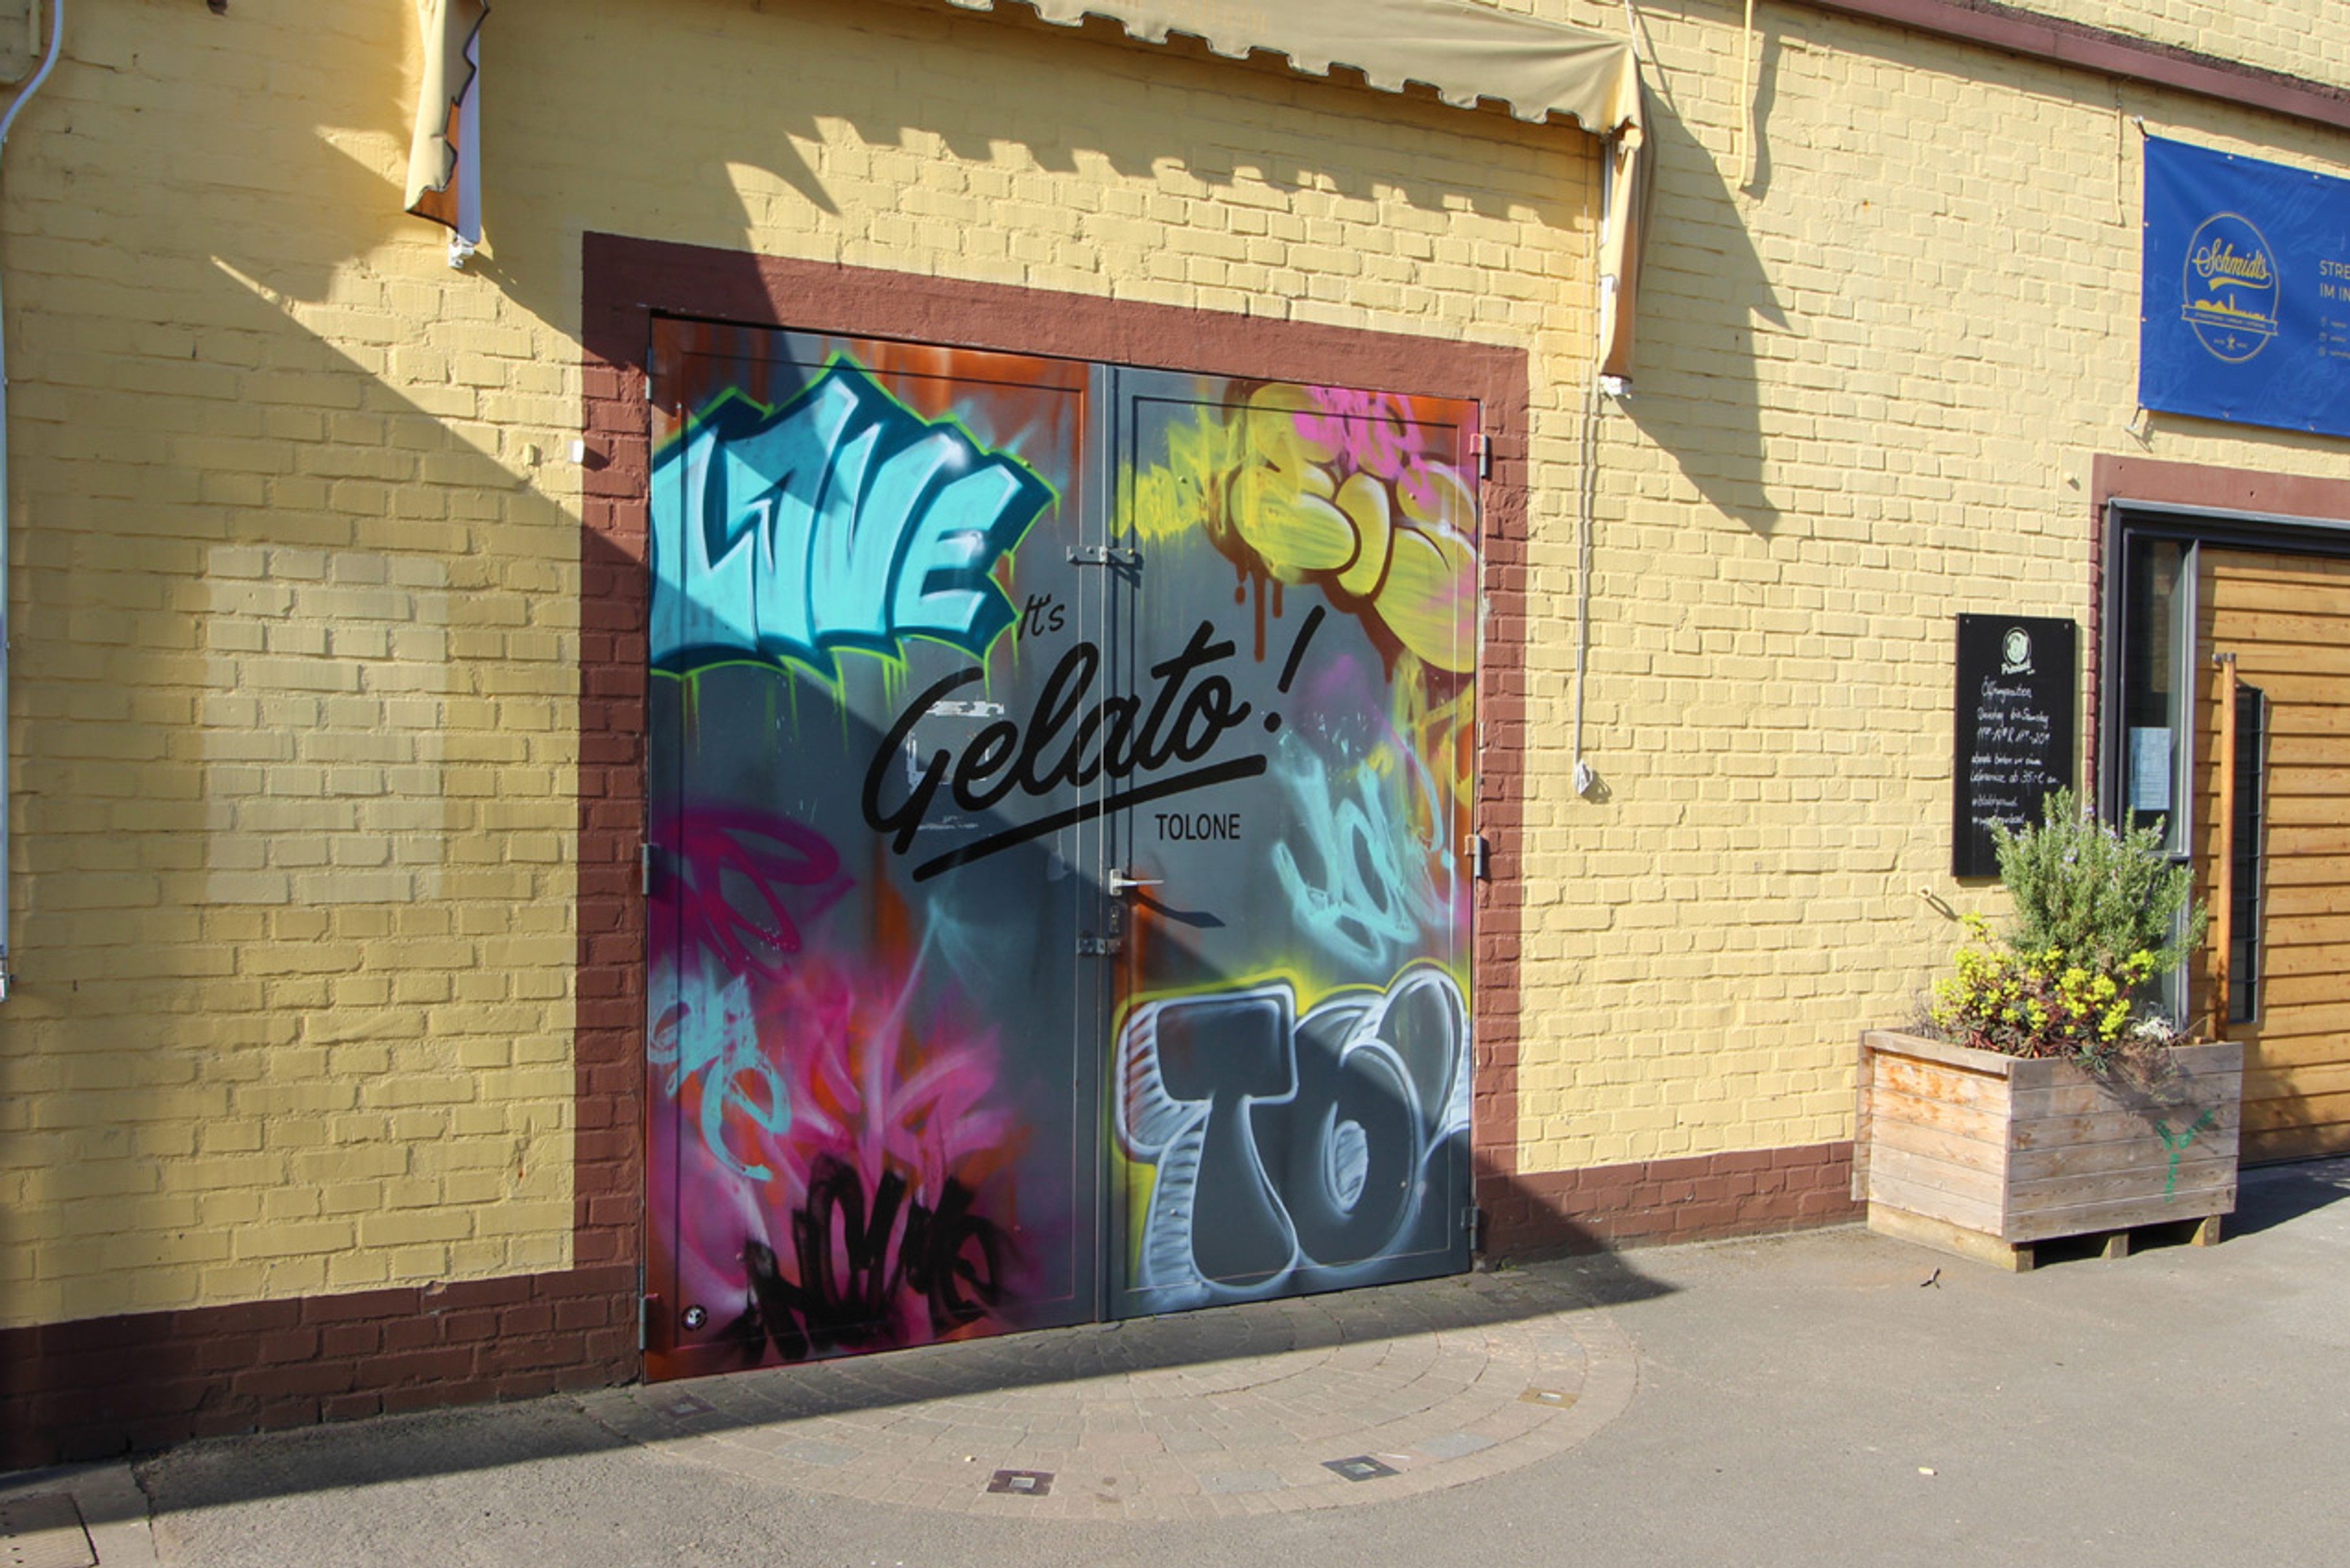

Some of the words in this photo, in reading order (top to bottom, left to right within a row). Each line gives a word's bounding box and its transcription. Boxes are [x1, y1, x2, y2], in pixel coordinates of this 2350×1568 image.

[2320, 282, 2335, 299] IM
[1018, 592, 1066, 641] It's
[861, 605, 1326, 856] Gelato!
[1154, 813, 1241, 841] TOLONE
